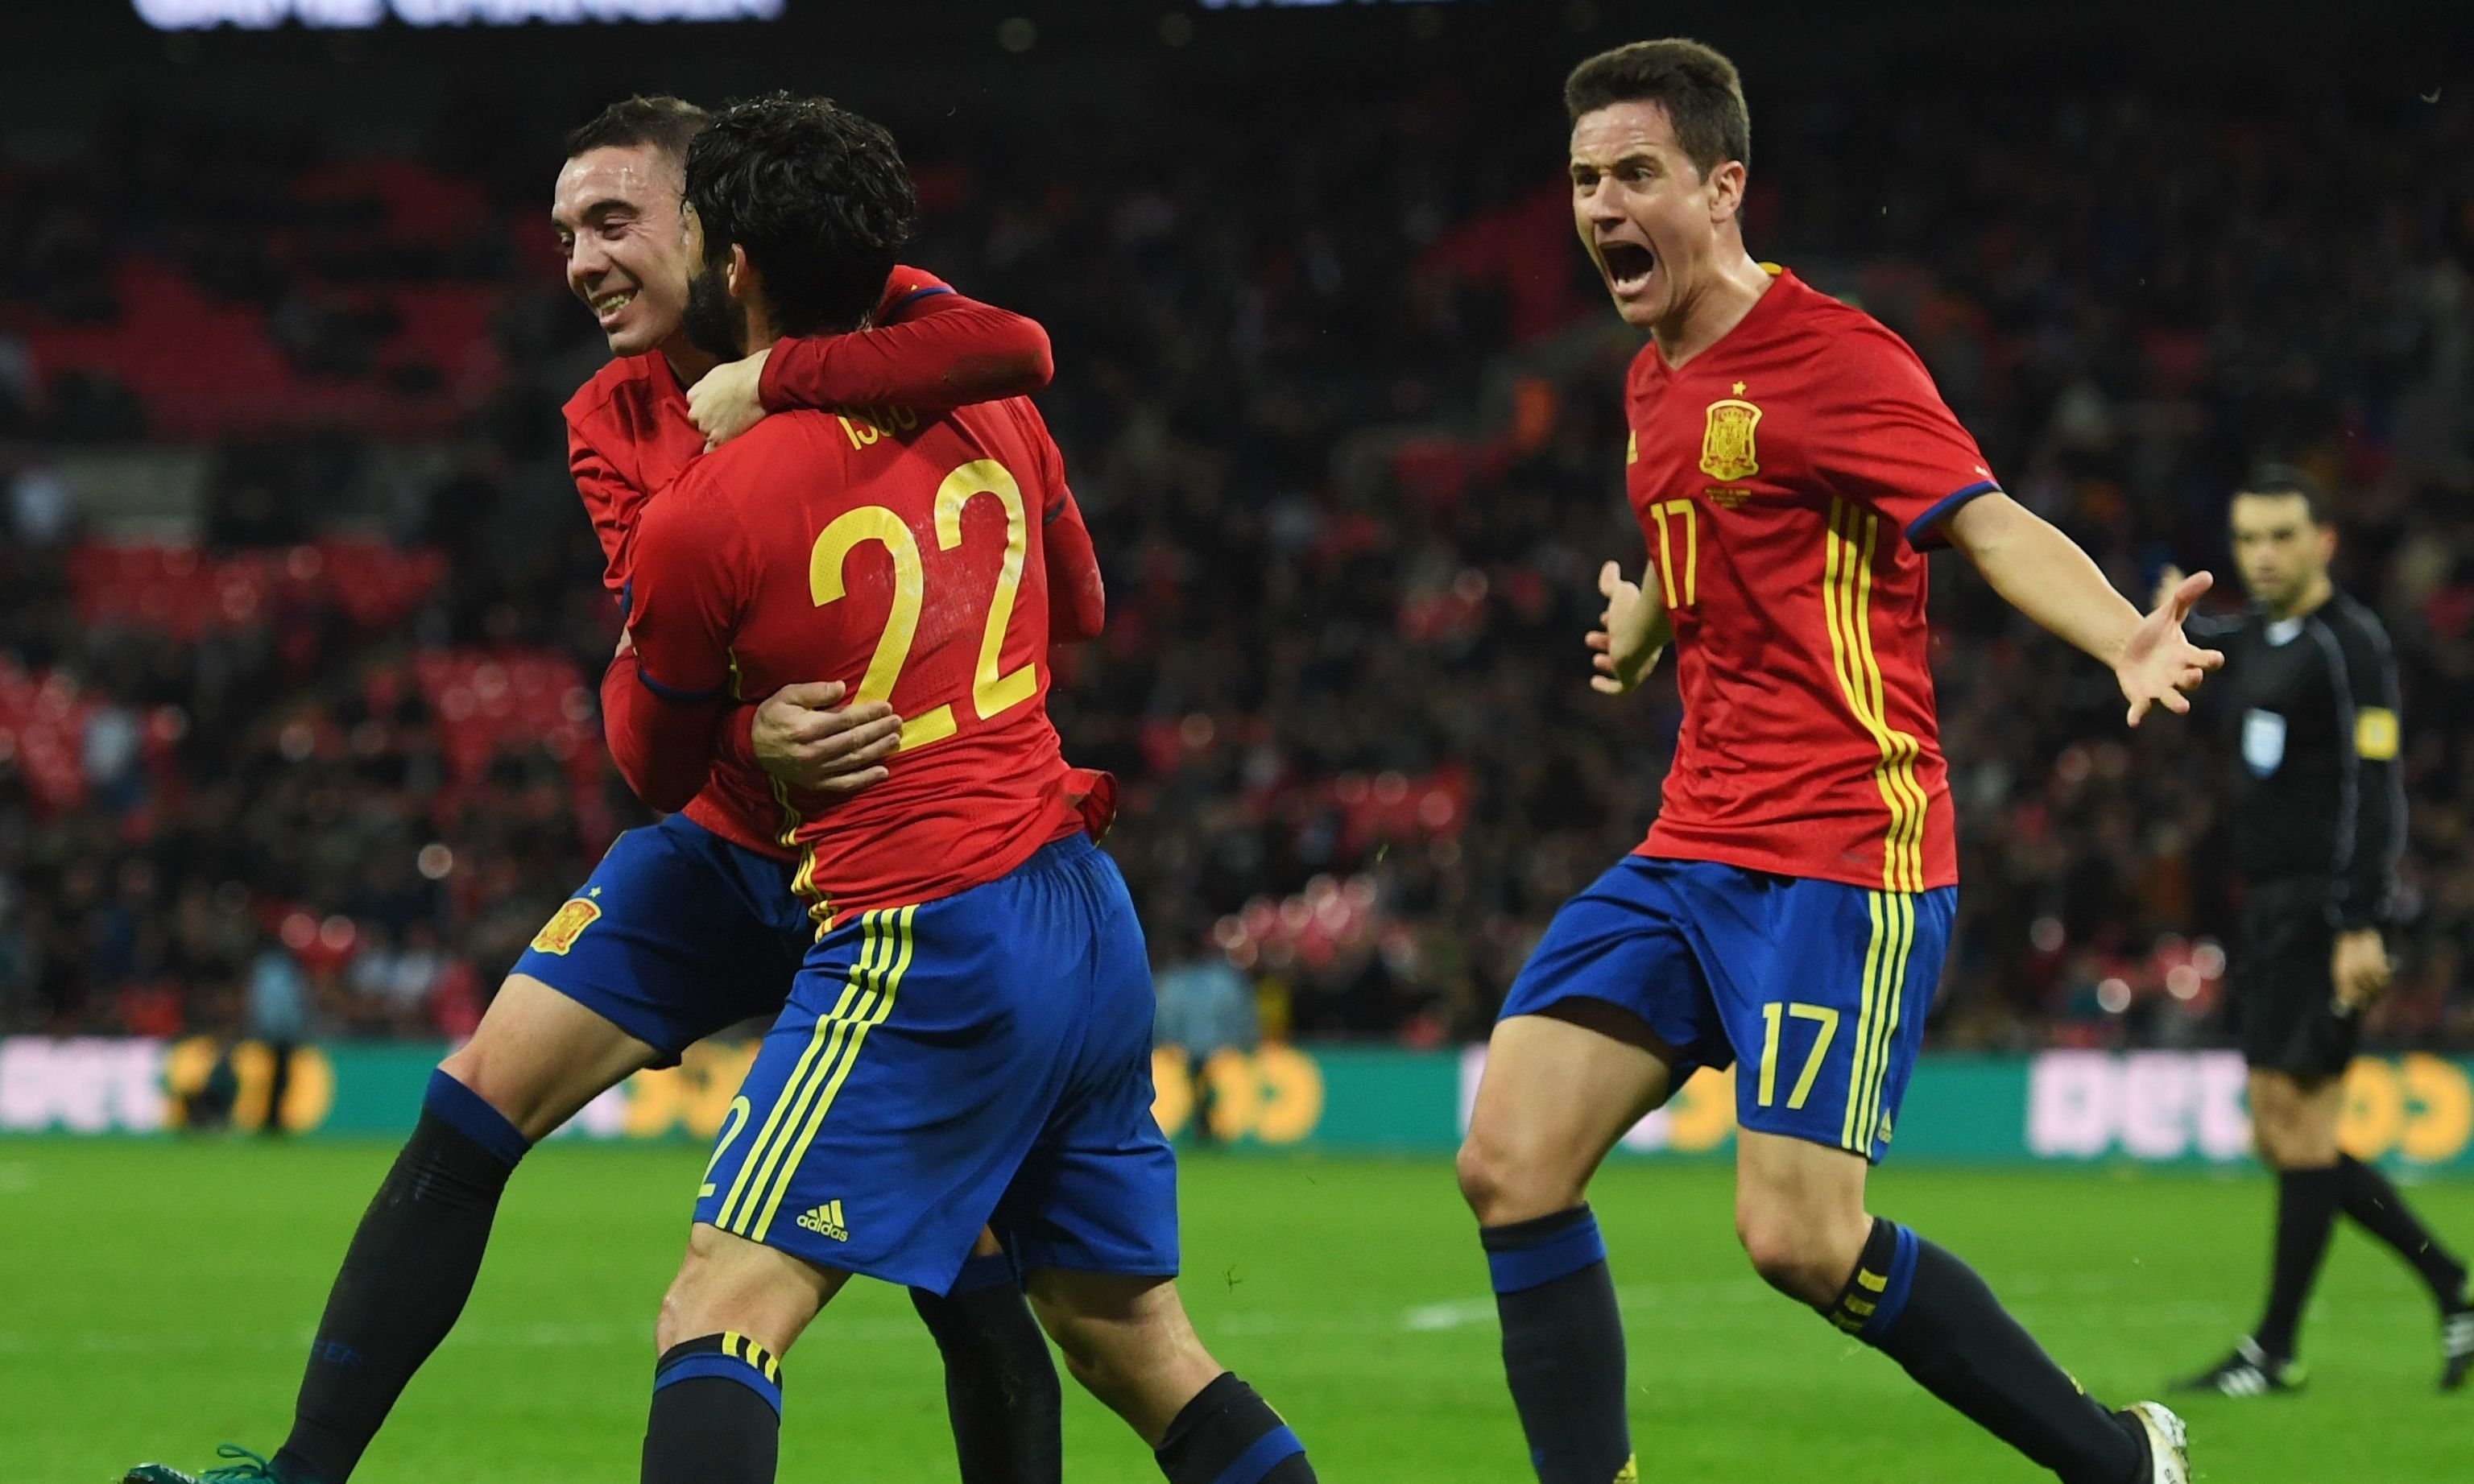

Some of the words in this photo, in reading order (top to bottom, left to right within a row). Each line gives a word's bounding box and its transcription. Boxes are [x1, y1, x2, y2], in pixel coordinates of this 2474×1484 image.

[809, 458, 1038, 754] 22
[1649, 498, 1697, 610] 17
[1757, 1001, 1839, 1110] 17
[796, 1214, 849, 1242] adidas
